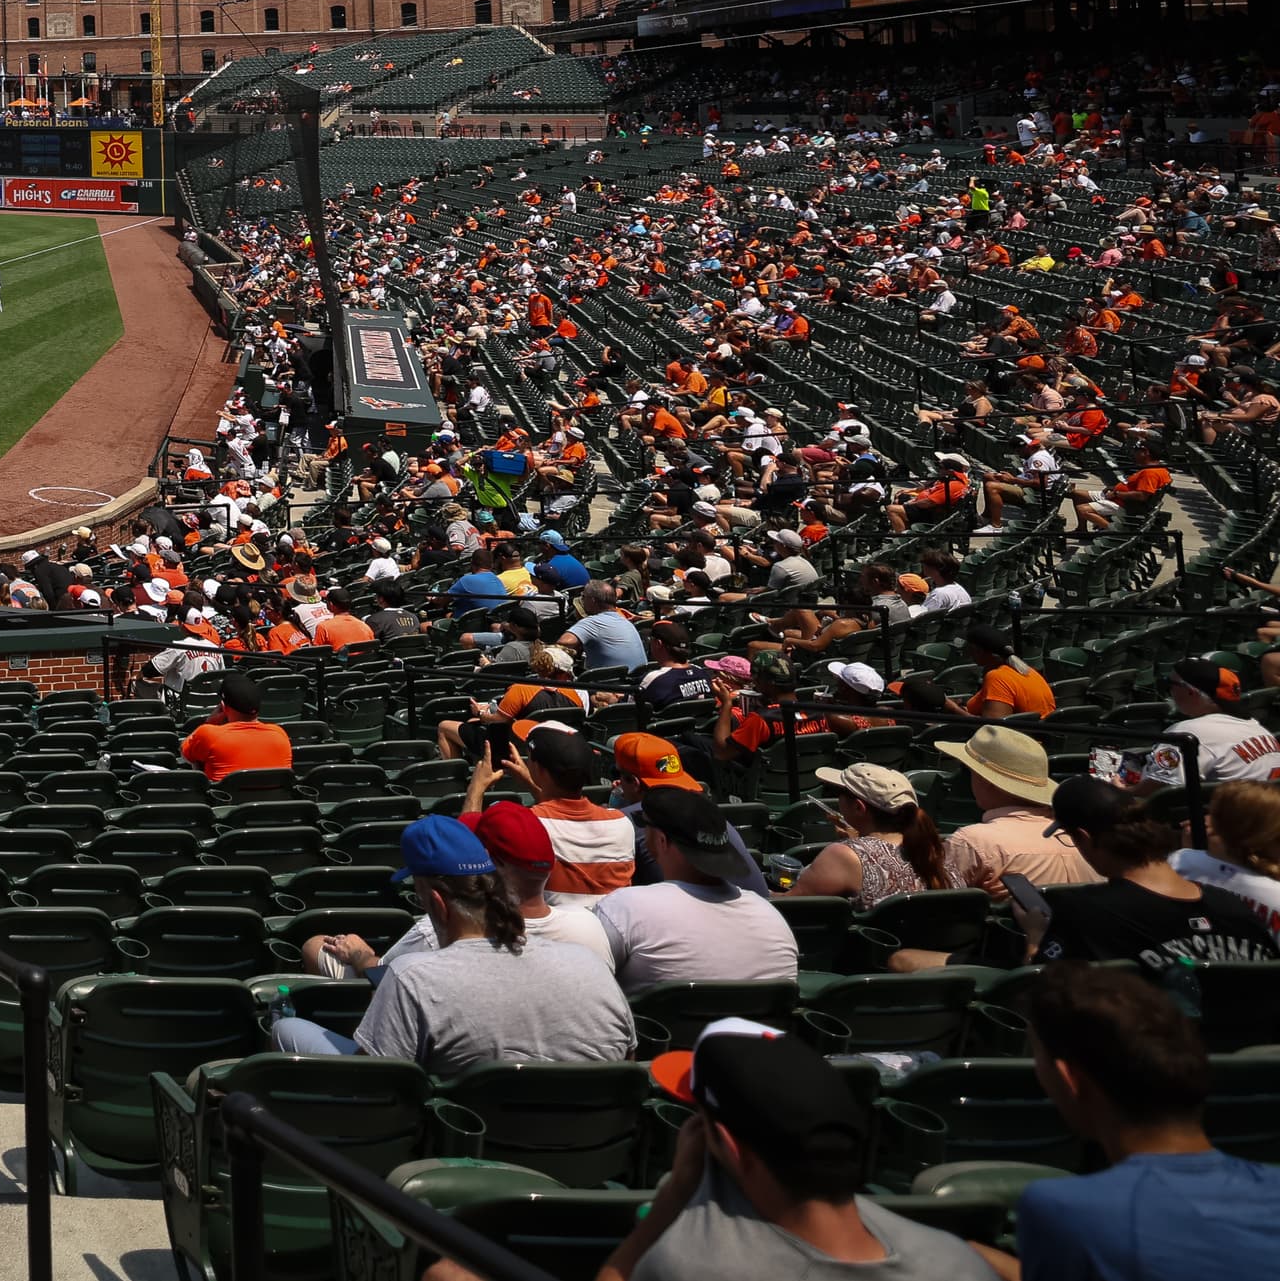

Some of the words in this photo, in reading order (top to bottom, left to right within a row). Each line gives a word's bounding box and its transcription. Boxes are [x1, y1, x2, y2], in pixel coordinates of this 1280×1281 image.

[5, 118, 53, 127] Personal
[55, 118, 89, 127] Loans
[14, 189, 51, 204] HIGH'S
[76, 189, 116, 198] CARROLL
[679, 679, 710, 698] ROBERTS
